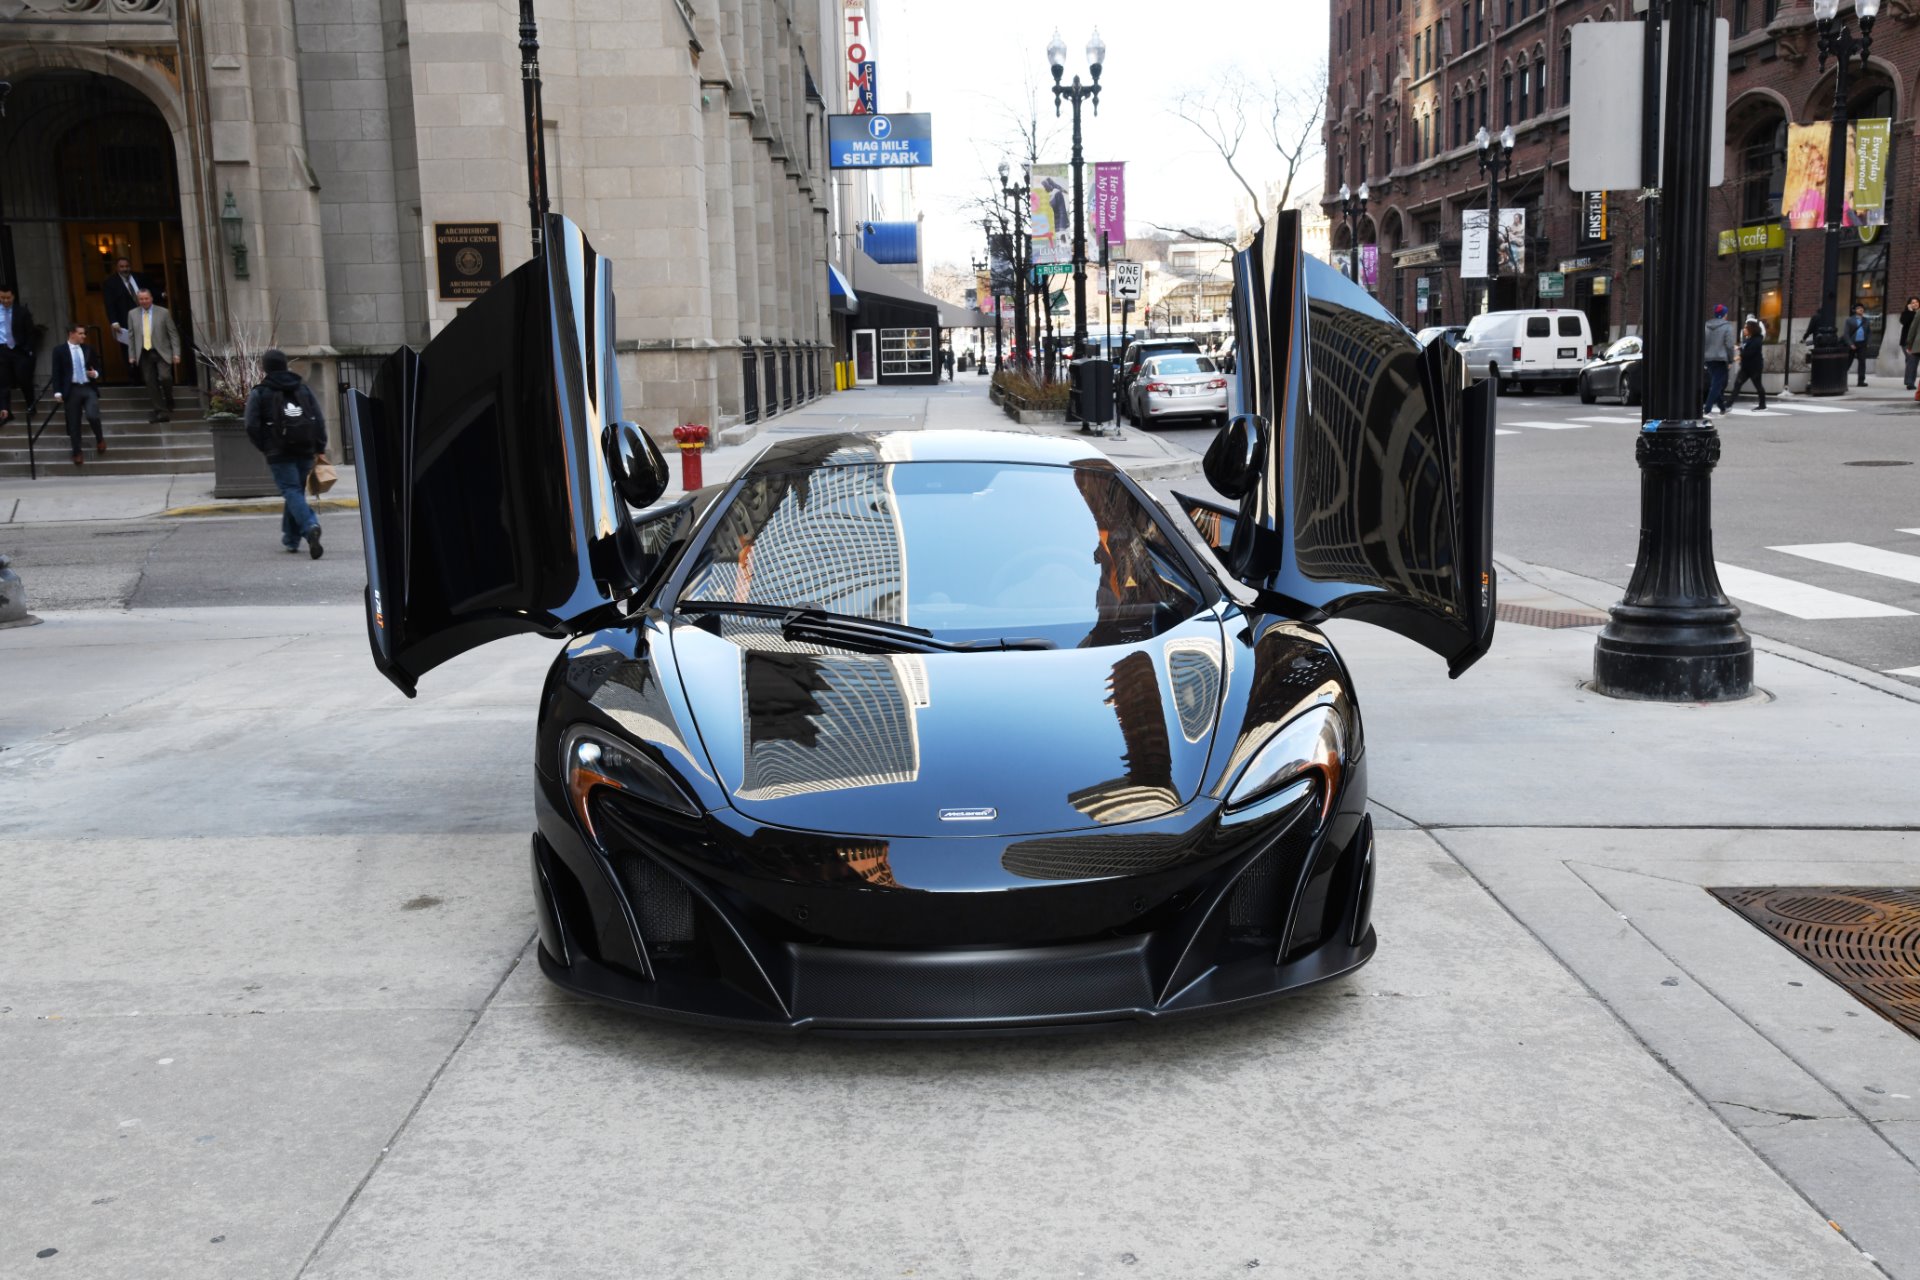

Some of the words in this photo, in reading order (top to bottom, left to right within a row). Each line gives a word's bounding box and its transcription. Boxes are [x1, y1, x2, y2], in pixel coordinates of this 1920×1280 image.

[865, 64, 874, 115] GHIRA
[874, 119, 887, 136] P
[852, 141, 879, 151] MAG
[881, 140, 909, 151] MILE
[842, 153, 878, 165] SELF
[880, 151, 920, 164] PARK
[1858, 137, 1870, 191] Englewood
[1868, 136, 1883, 183] Everyday
[1097, 175, 1108, 192] My
[1109, 175, 1119, 194] Her
[1589, 192, 1602, 238] EINSTEIN
[438, 236, 468, 244] QUIGLEY
[469, 235, 497, 243] CENTER
[445, 227, 489, 235] ARCHBISHOP
[1743, 228, 1767, 246] café
[1118, 265, 1138, 275] ONE
[1118, 276, 1139, 285] WAY
